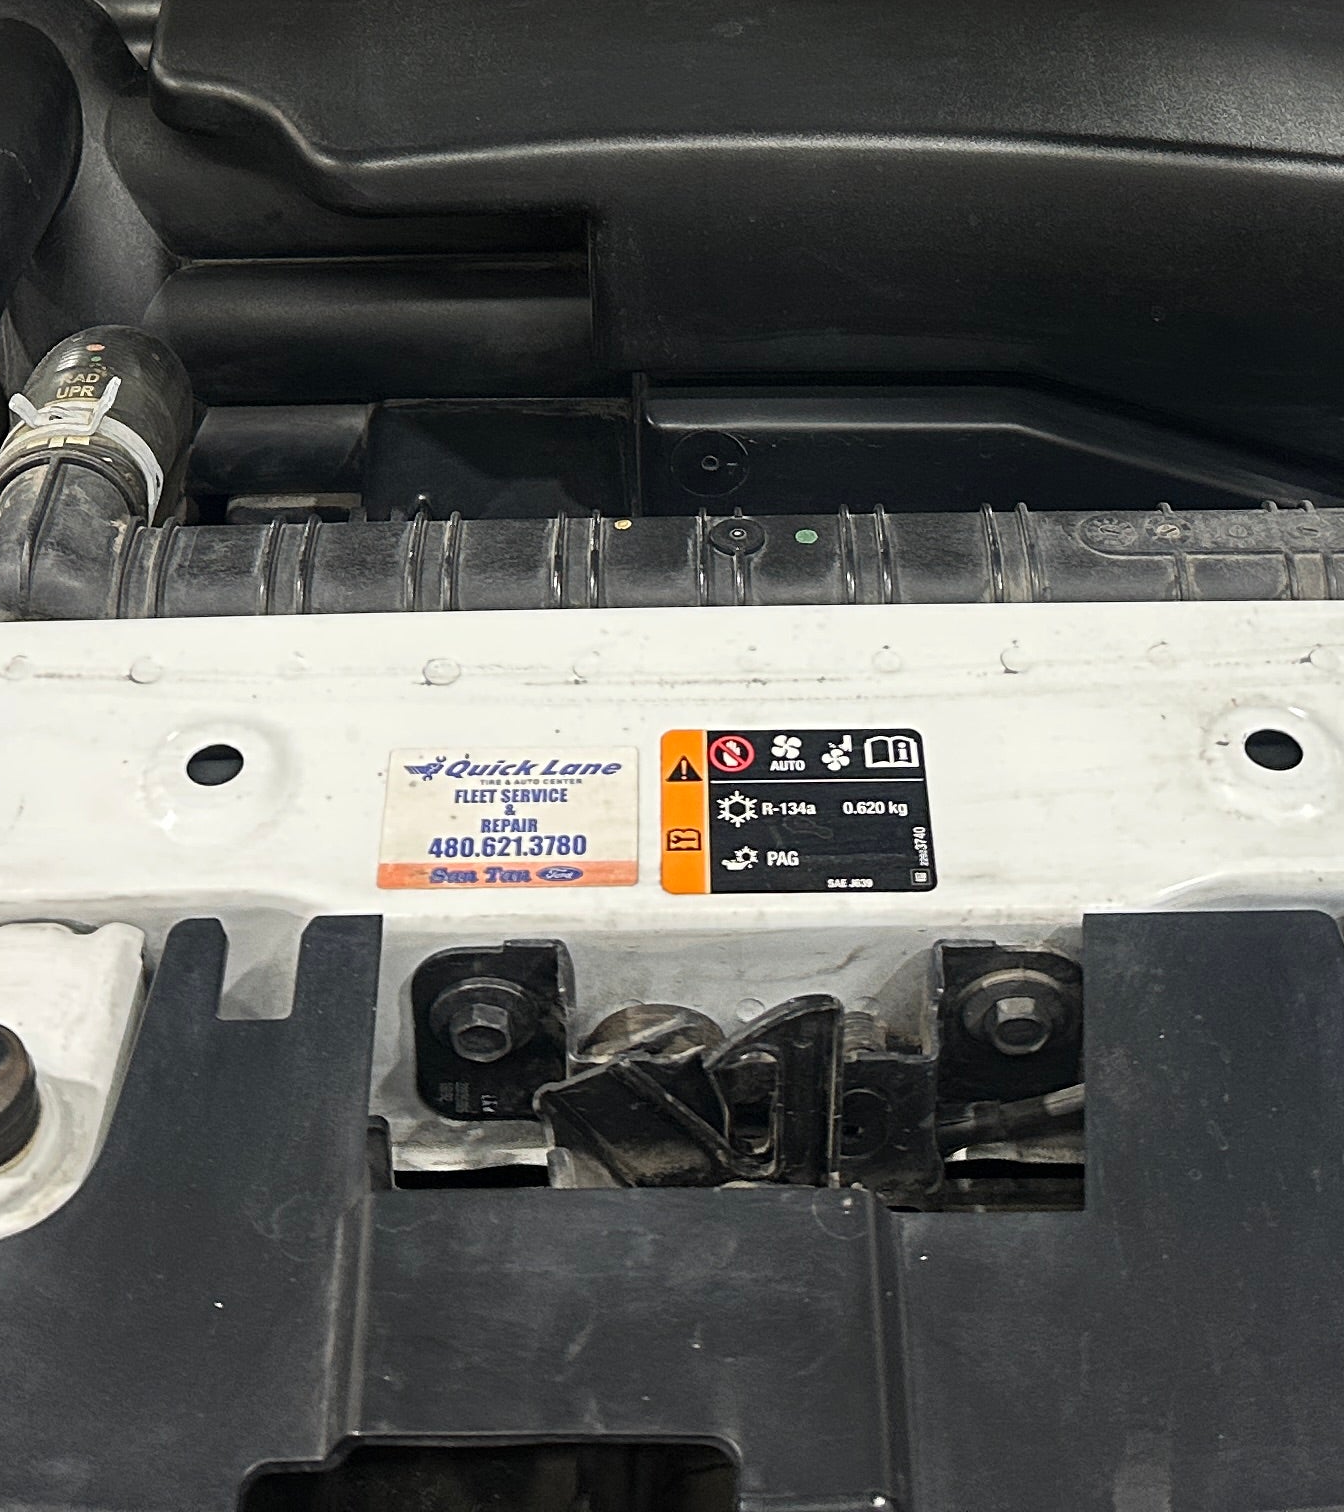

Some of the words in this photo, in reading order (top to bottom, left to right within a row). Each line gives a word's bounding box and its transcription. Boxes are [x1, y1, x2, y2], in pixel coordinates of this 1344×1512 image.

[56, 385, 95, 399] UPR
[445, 759, 540, 779] Quick
[540, 759, 623, 776] Lane
[770, 760, 806, 771] AUTO
[455, 789, 498, 803] FLEET
[500, 788, 568, 803] SERVICE
[504, 804, 516, 816] &
[761, 801, 817, 815] R-134a
[842, 801, 885, 815] 0.620
[888, 801, 908, 816] kg
[481, 818, 538, 833] REPAIR
[428, 834, 587, 858] 480.621.3780
[766, 850, 800, 866] PAG
[543, 867, 577, 880] Ford
[827, 878, 848, 888] SAE
